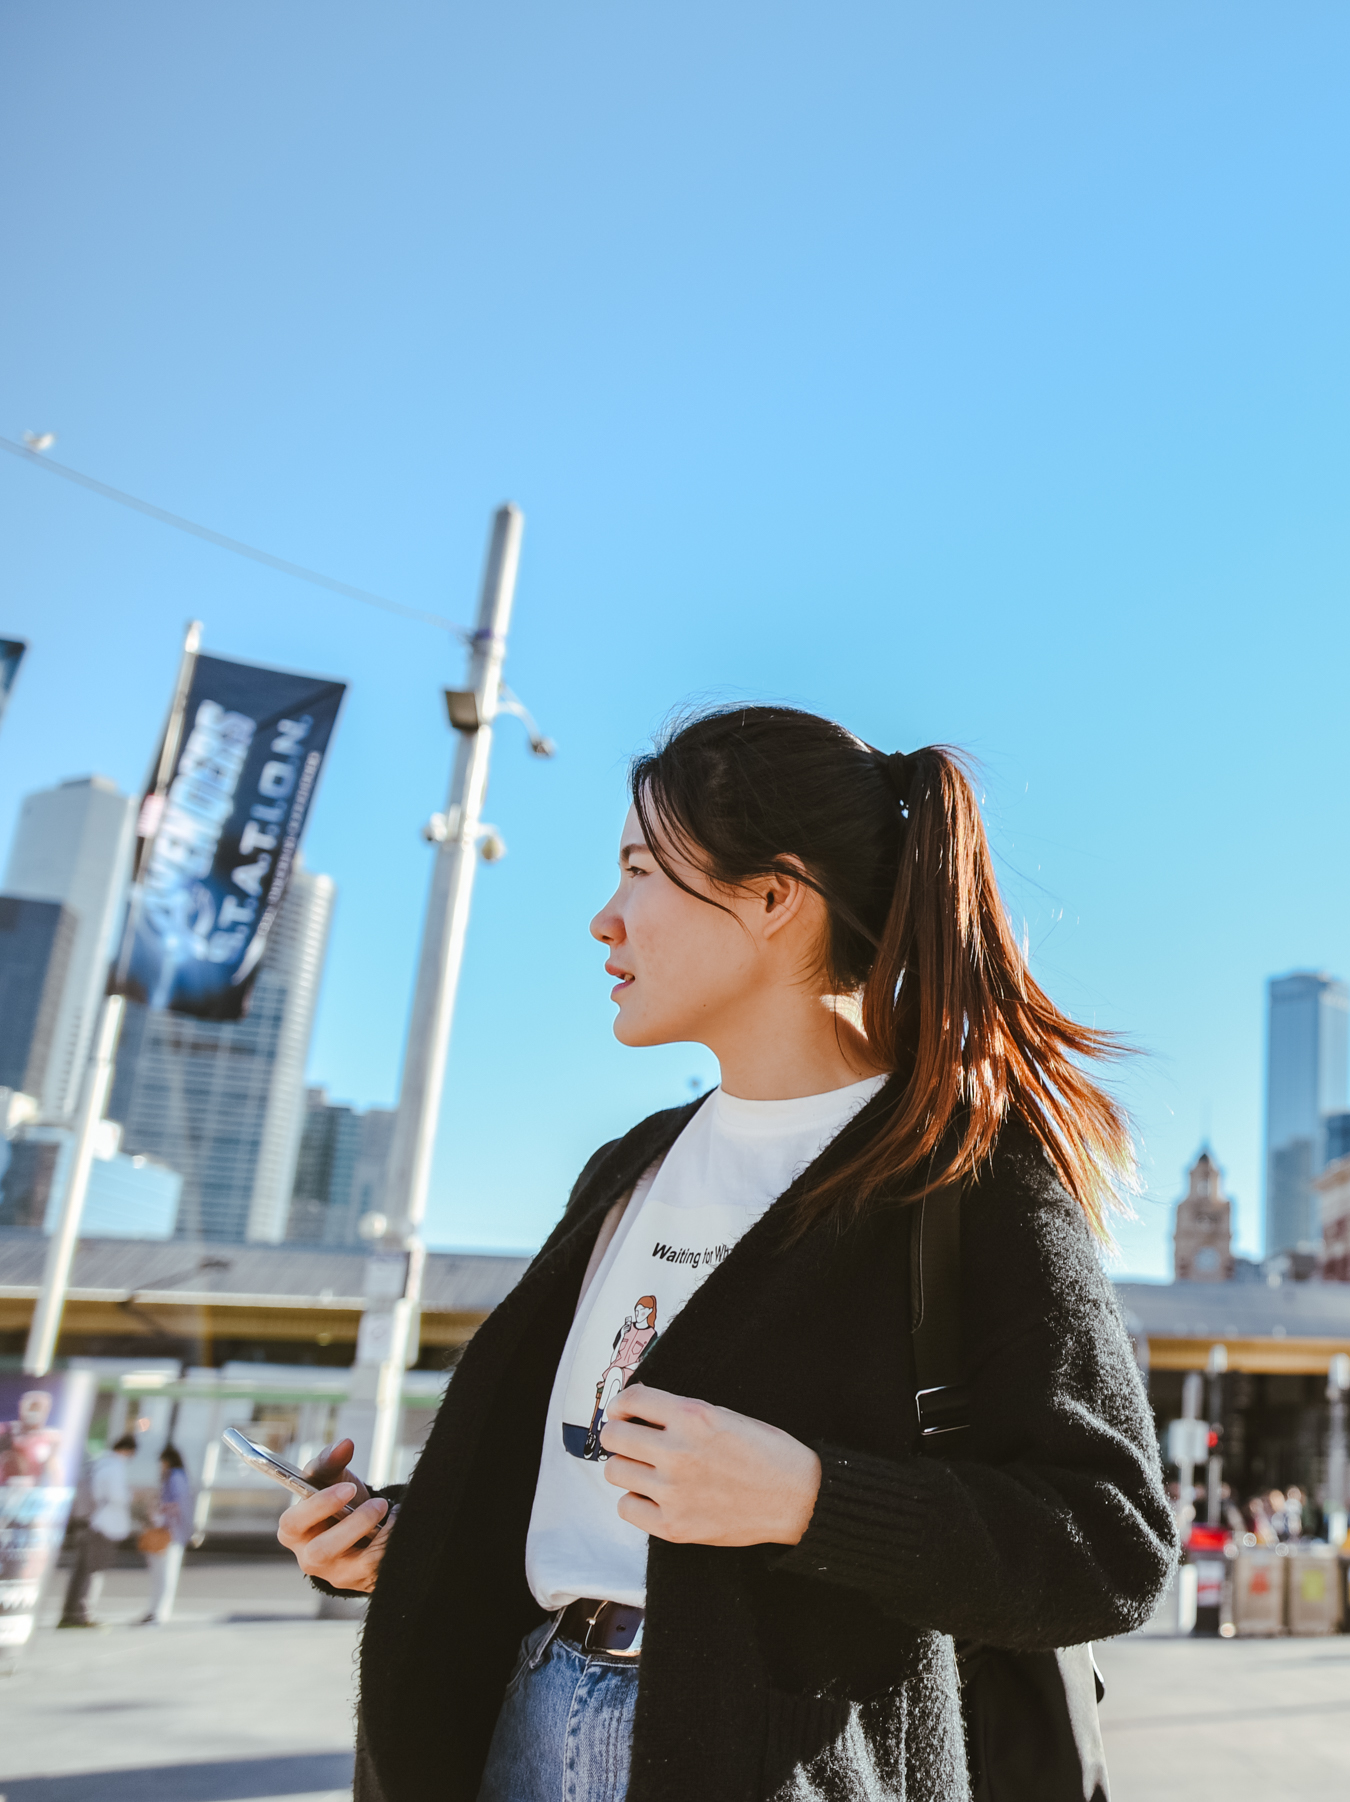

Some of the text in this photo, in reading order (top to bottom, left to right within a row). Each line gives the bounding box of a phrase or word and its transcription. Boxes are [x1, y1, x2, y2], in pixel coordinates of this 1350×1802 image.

[652, 1242, 731, 1269] Waiting for Wh
